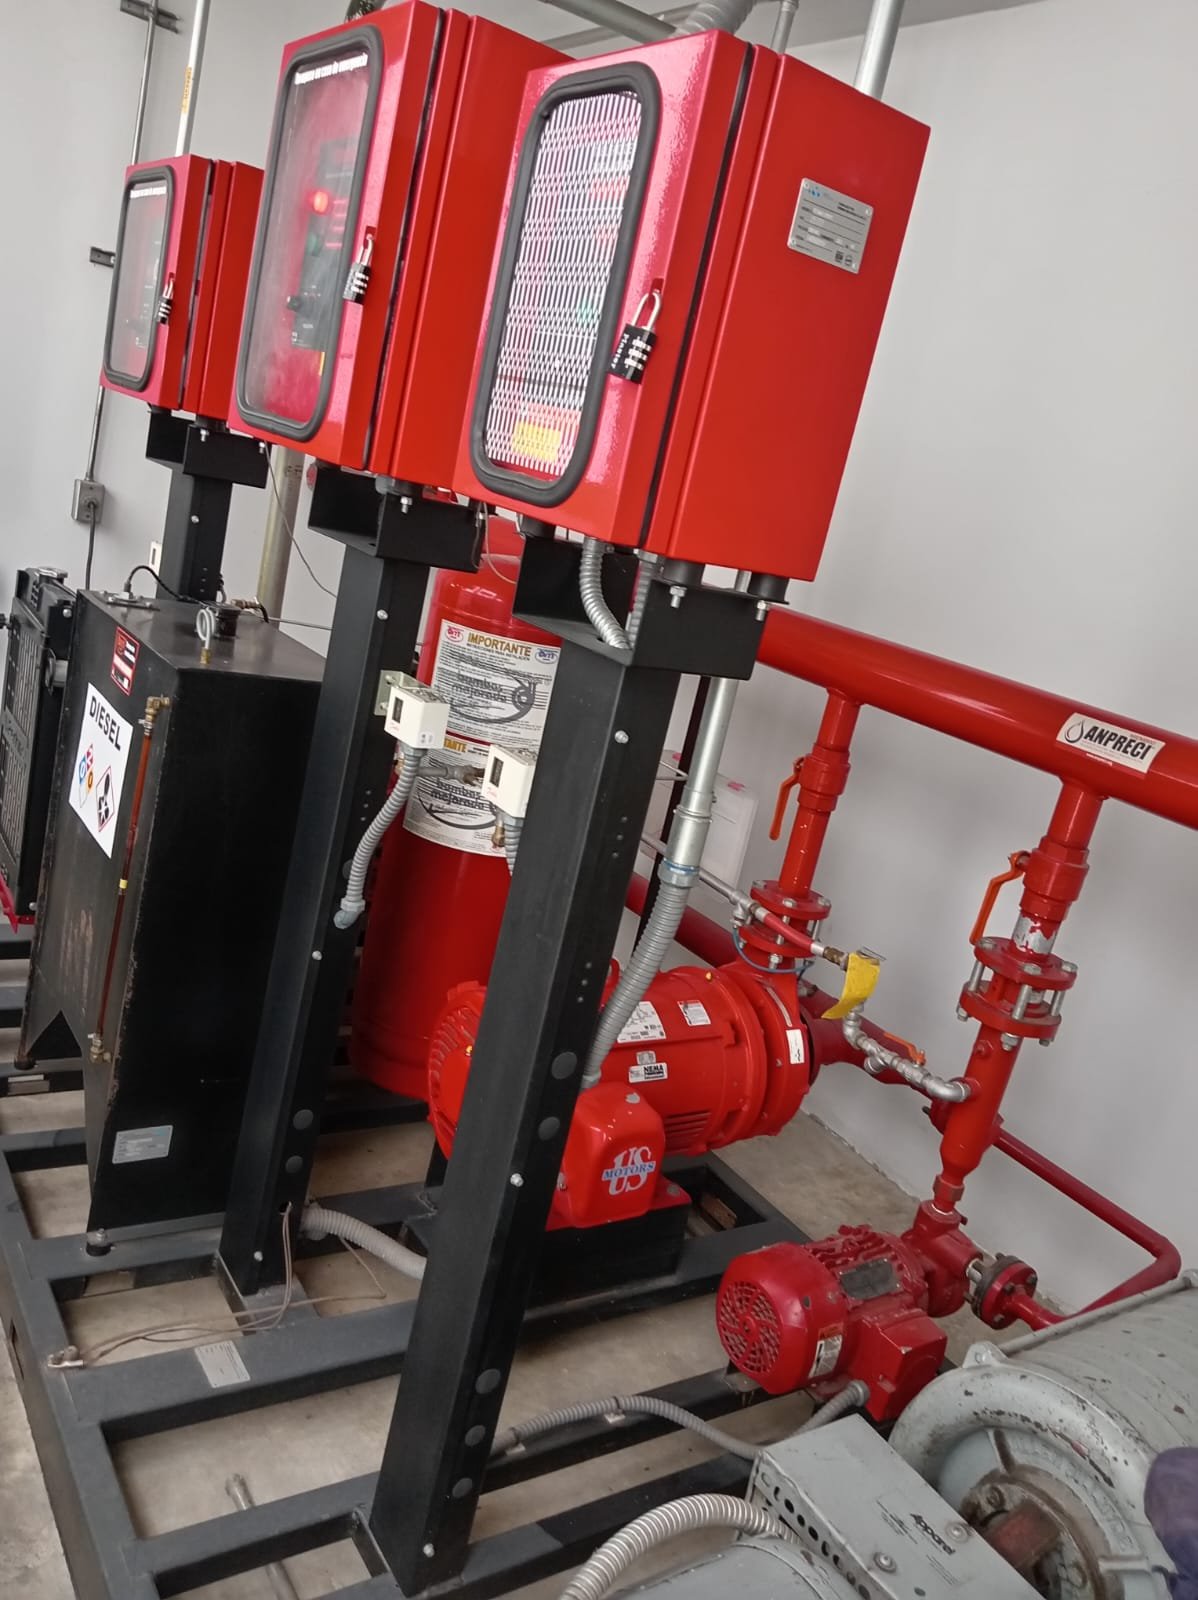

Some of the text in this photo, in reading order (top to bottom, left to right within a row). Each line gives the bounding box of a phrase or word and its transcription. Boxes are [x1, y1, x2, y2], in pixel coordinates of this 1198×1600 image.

[467, 631, 533, 657] IMPORTANTE
[89, 695, 122, 751] DIESEL
[1084, 725, 1152, 760] ANPRECI
[644, 1064, 664, 1073] NEMA
[603, 1161, 655, 1181] MOTORS
[609, 1146, 651, 1195] US
